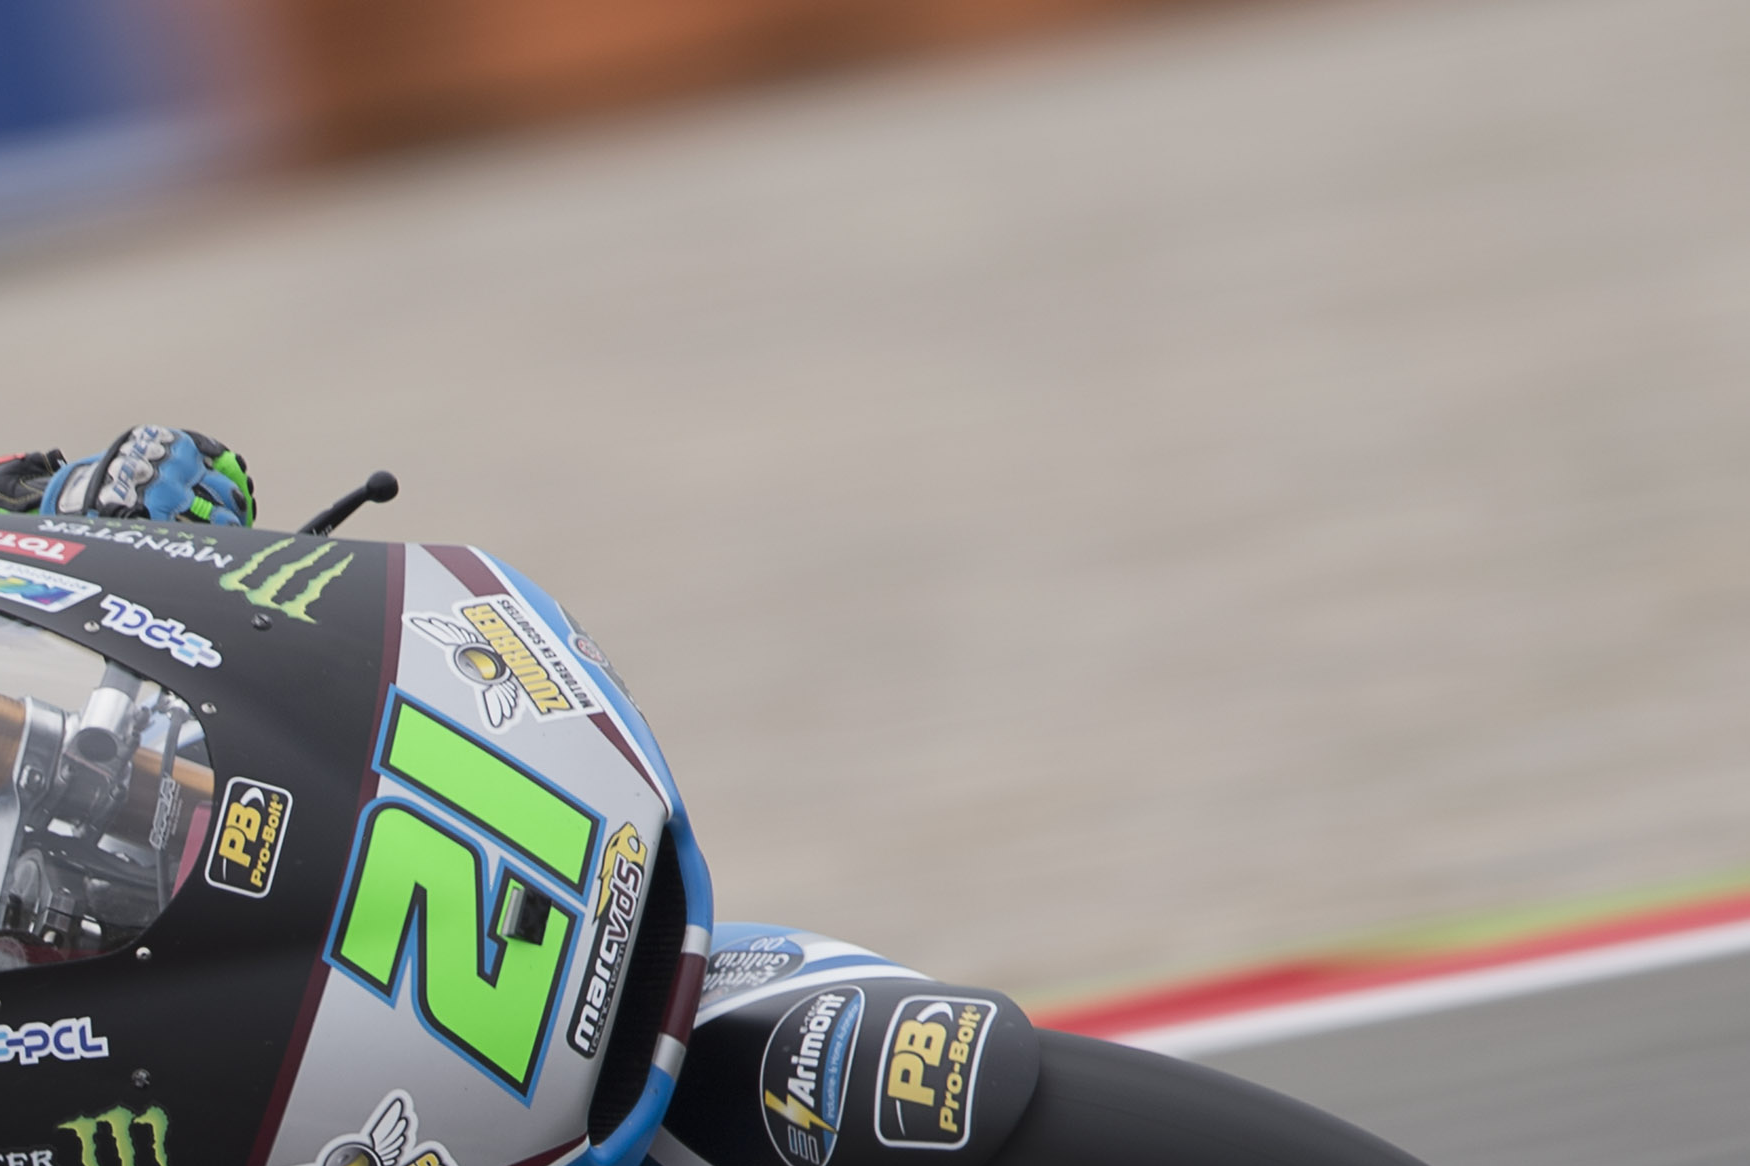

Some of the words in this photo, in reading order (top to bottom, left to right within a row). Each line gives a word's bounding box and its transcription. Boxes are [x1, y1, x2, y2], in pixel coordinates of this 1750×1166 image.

[460, 602, 574, 715] ZUURBIER
[218, 801, 261, 868] PB
[323, 683, 607, 1109] 21
[10, 1021, 107, 1063] PCL
[787, 993, 847, 1109] Arimont
[887, 1019, 947, 1107] PB
